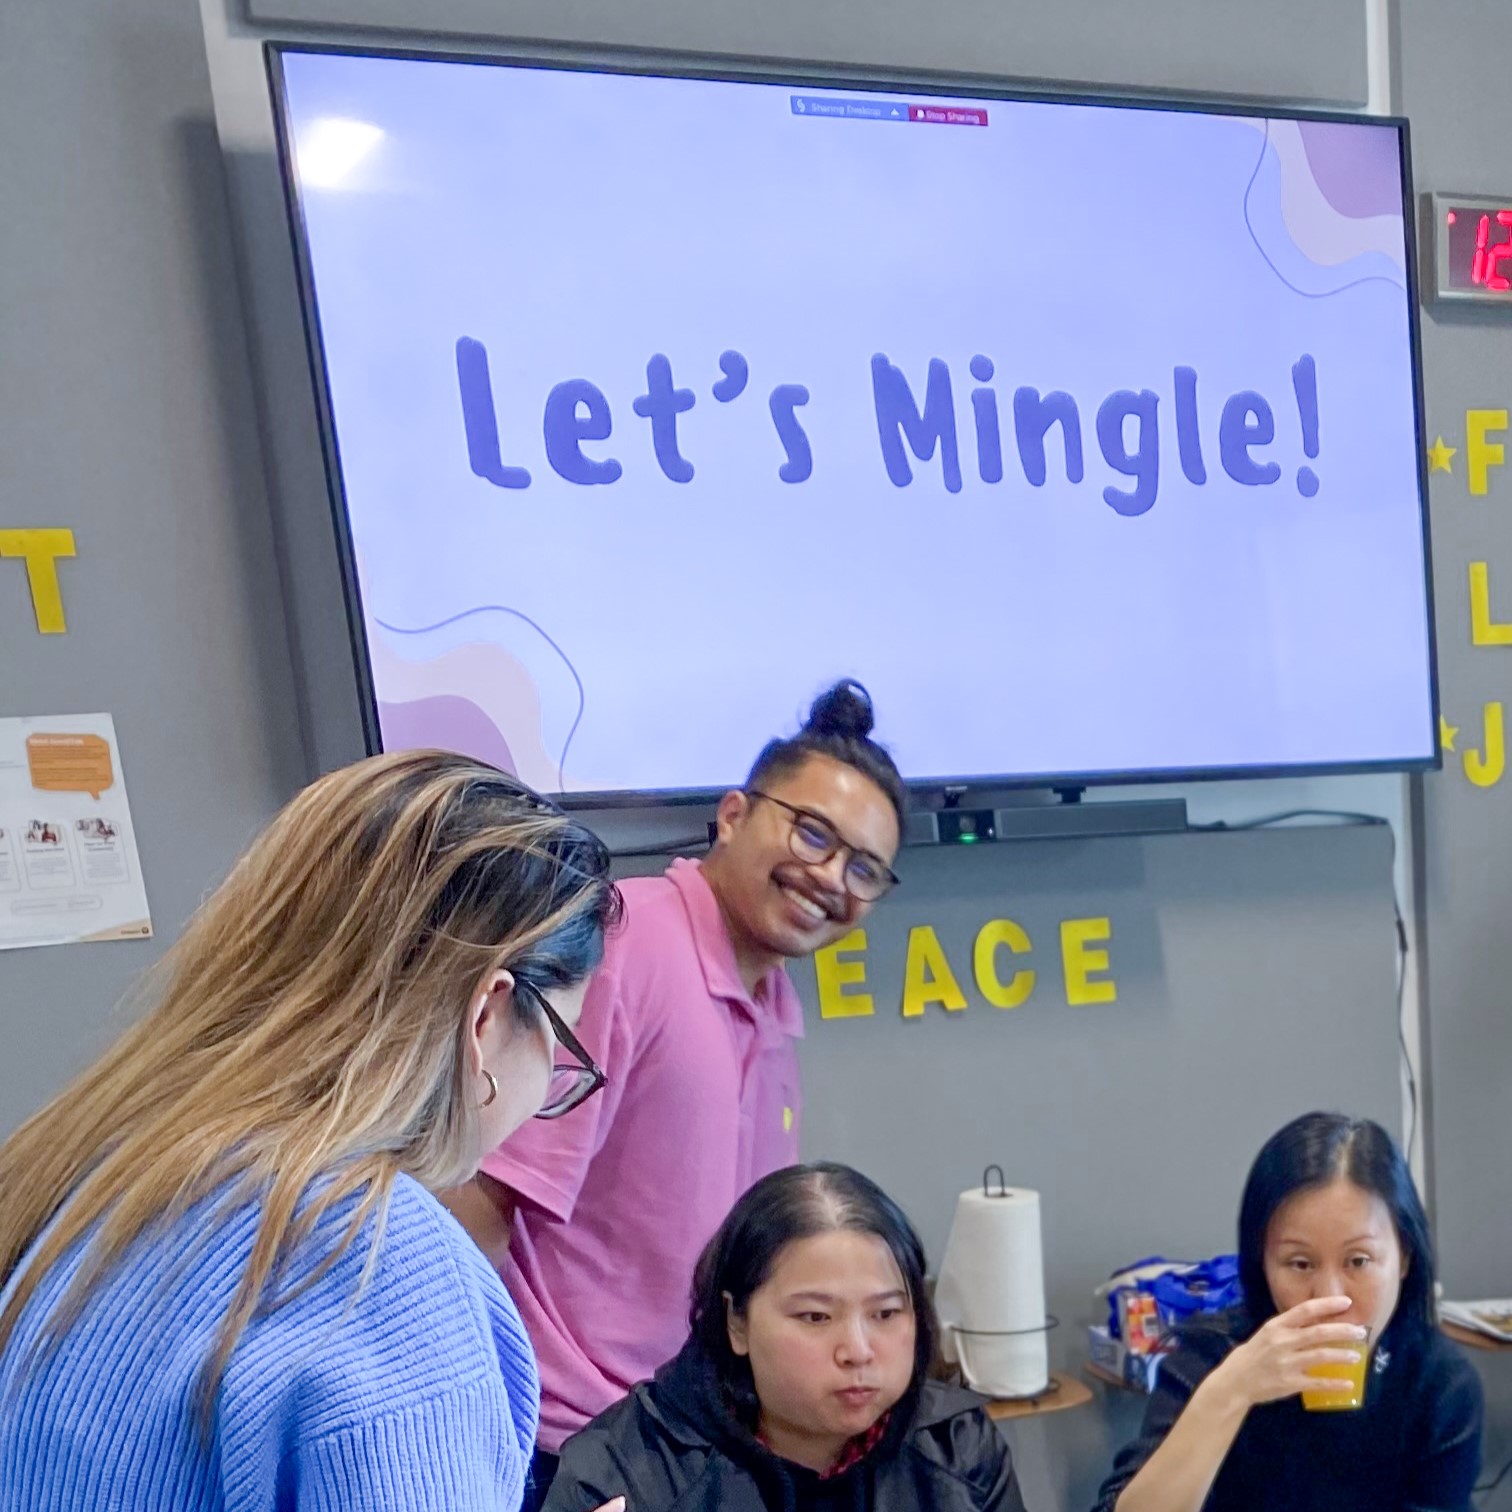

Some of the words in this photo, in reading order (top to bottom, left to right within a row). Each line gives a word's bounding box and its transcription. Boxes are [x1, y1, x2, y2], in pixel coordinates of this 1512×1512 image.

[926, 112, 946, 121] Stop
[455, 336, 813, 489] Let's
[871, 352, 1319, 516] Mingle!
